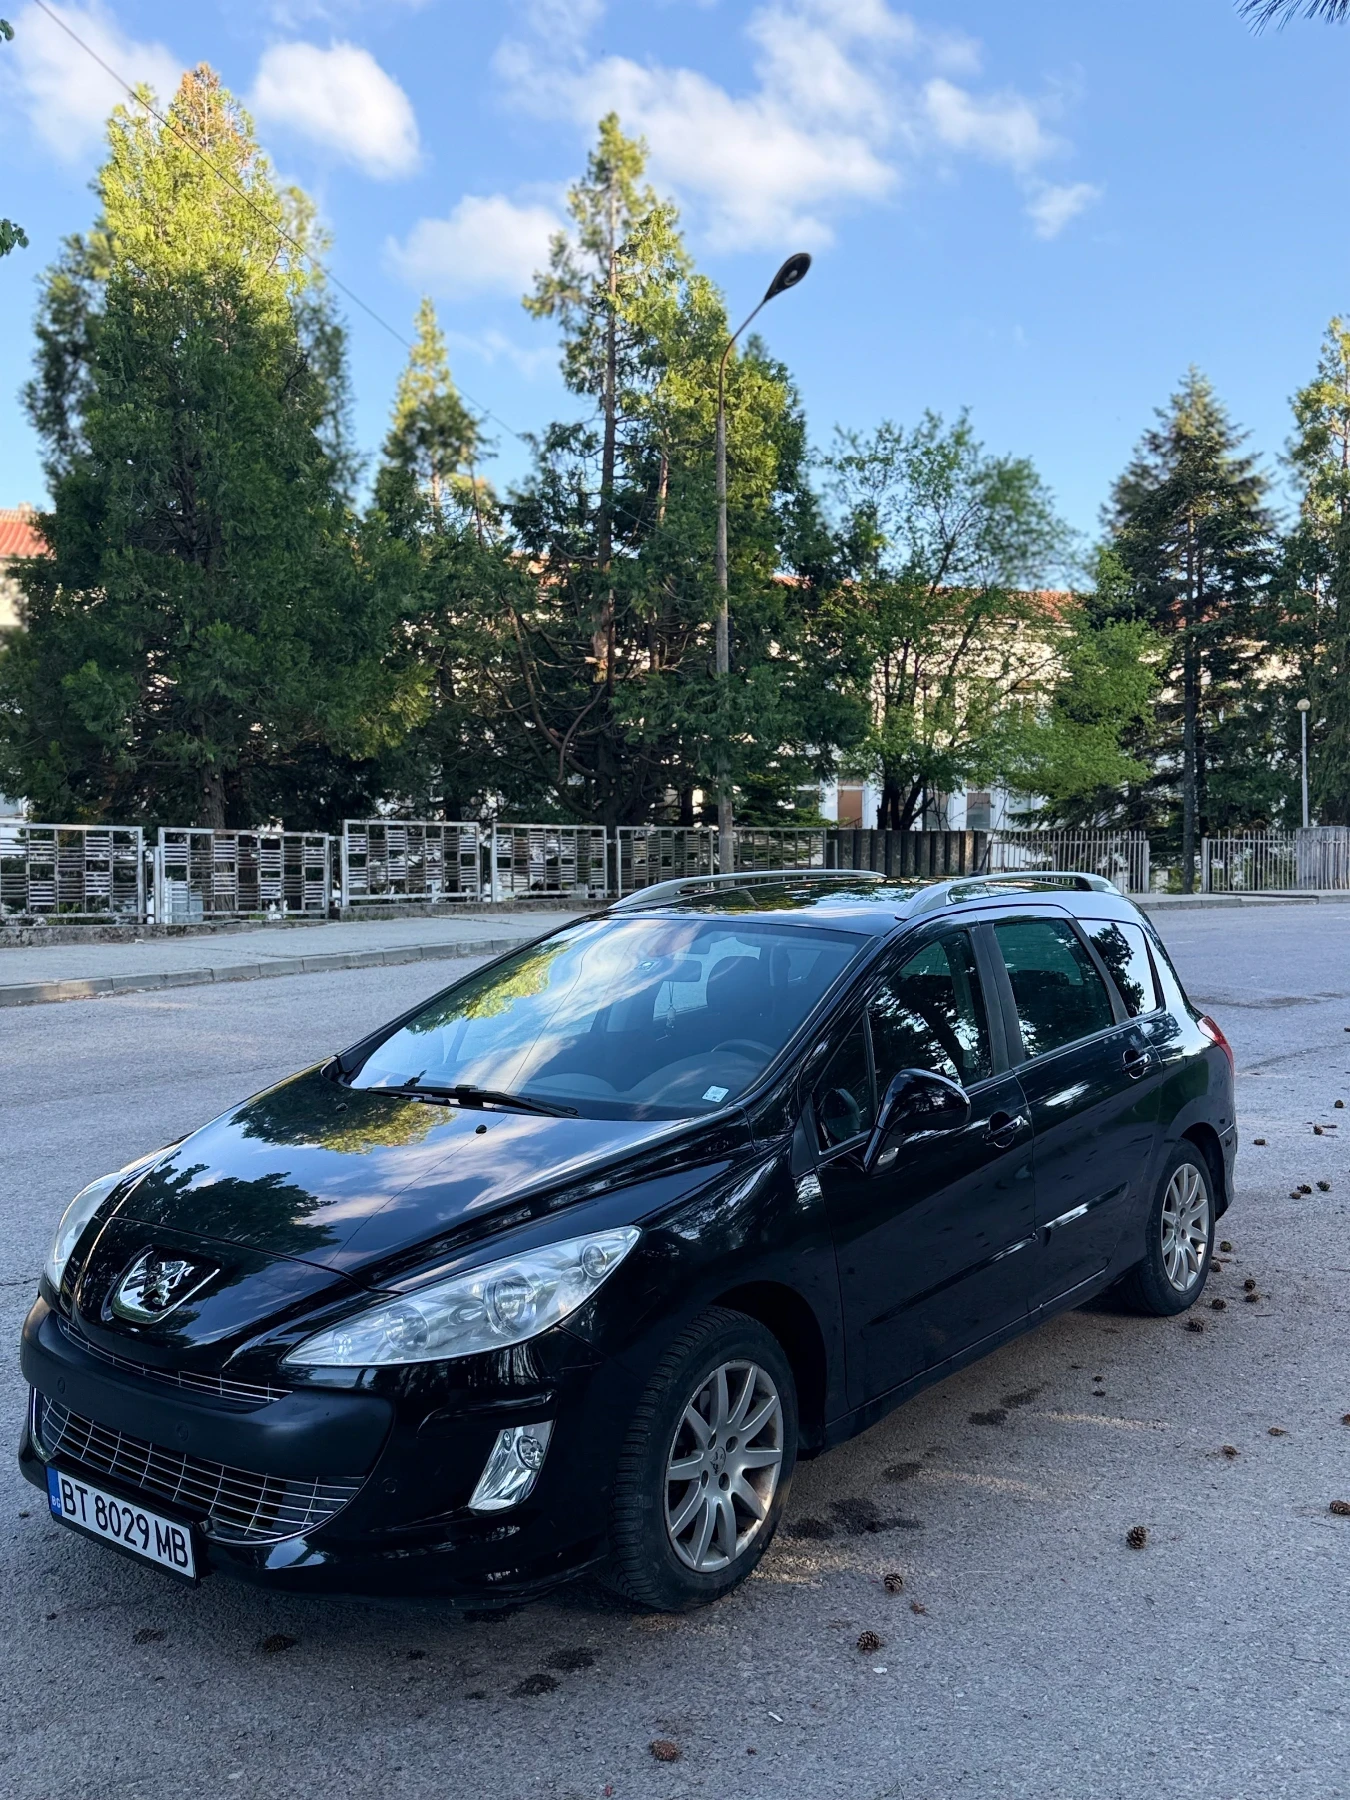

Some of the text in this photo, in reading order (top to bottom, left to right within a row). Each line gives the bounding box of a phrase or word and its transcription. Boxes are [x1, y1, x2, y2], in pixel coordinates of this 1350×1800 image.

[51, 1495, 61, 1508] BG
[61, 1478, 188, 1568] BT 8029 MB
